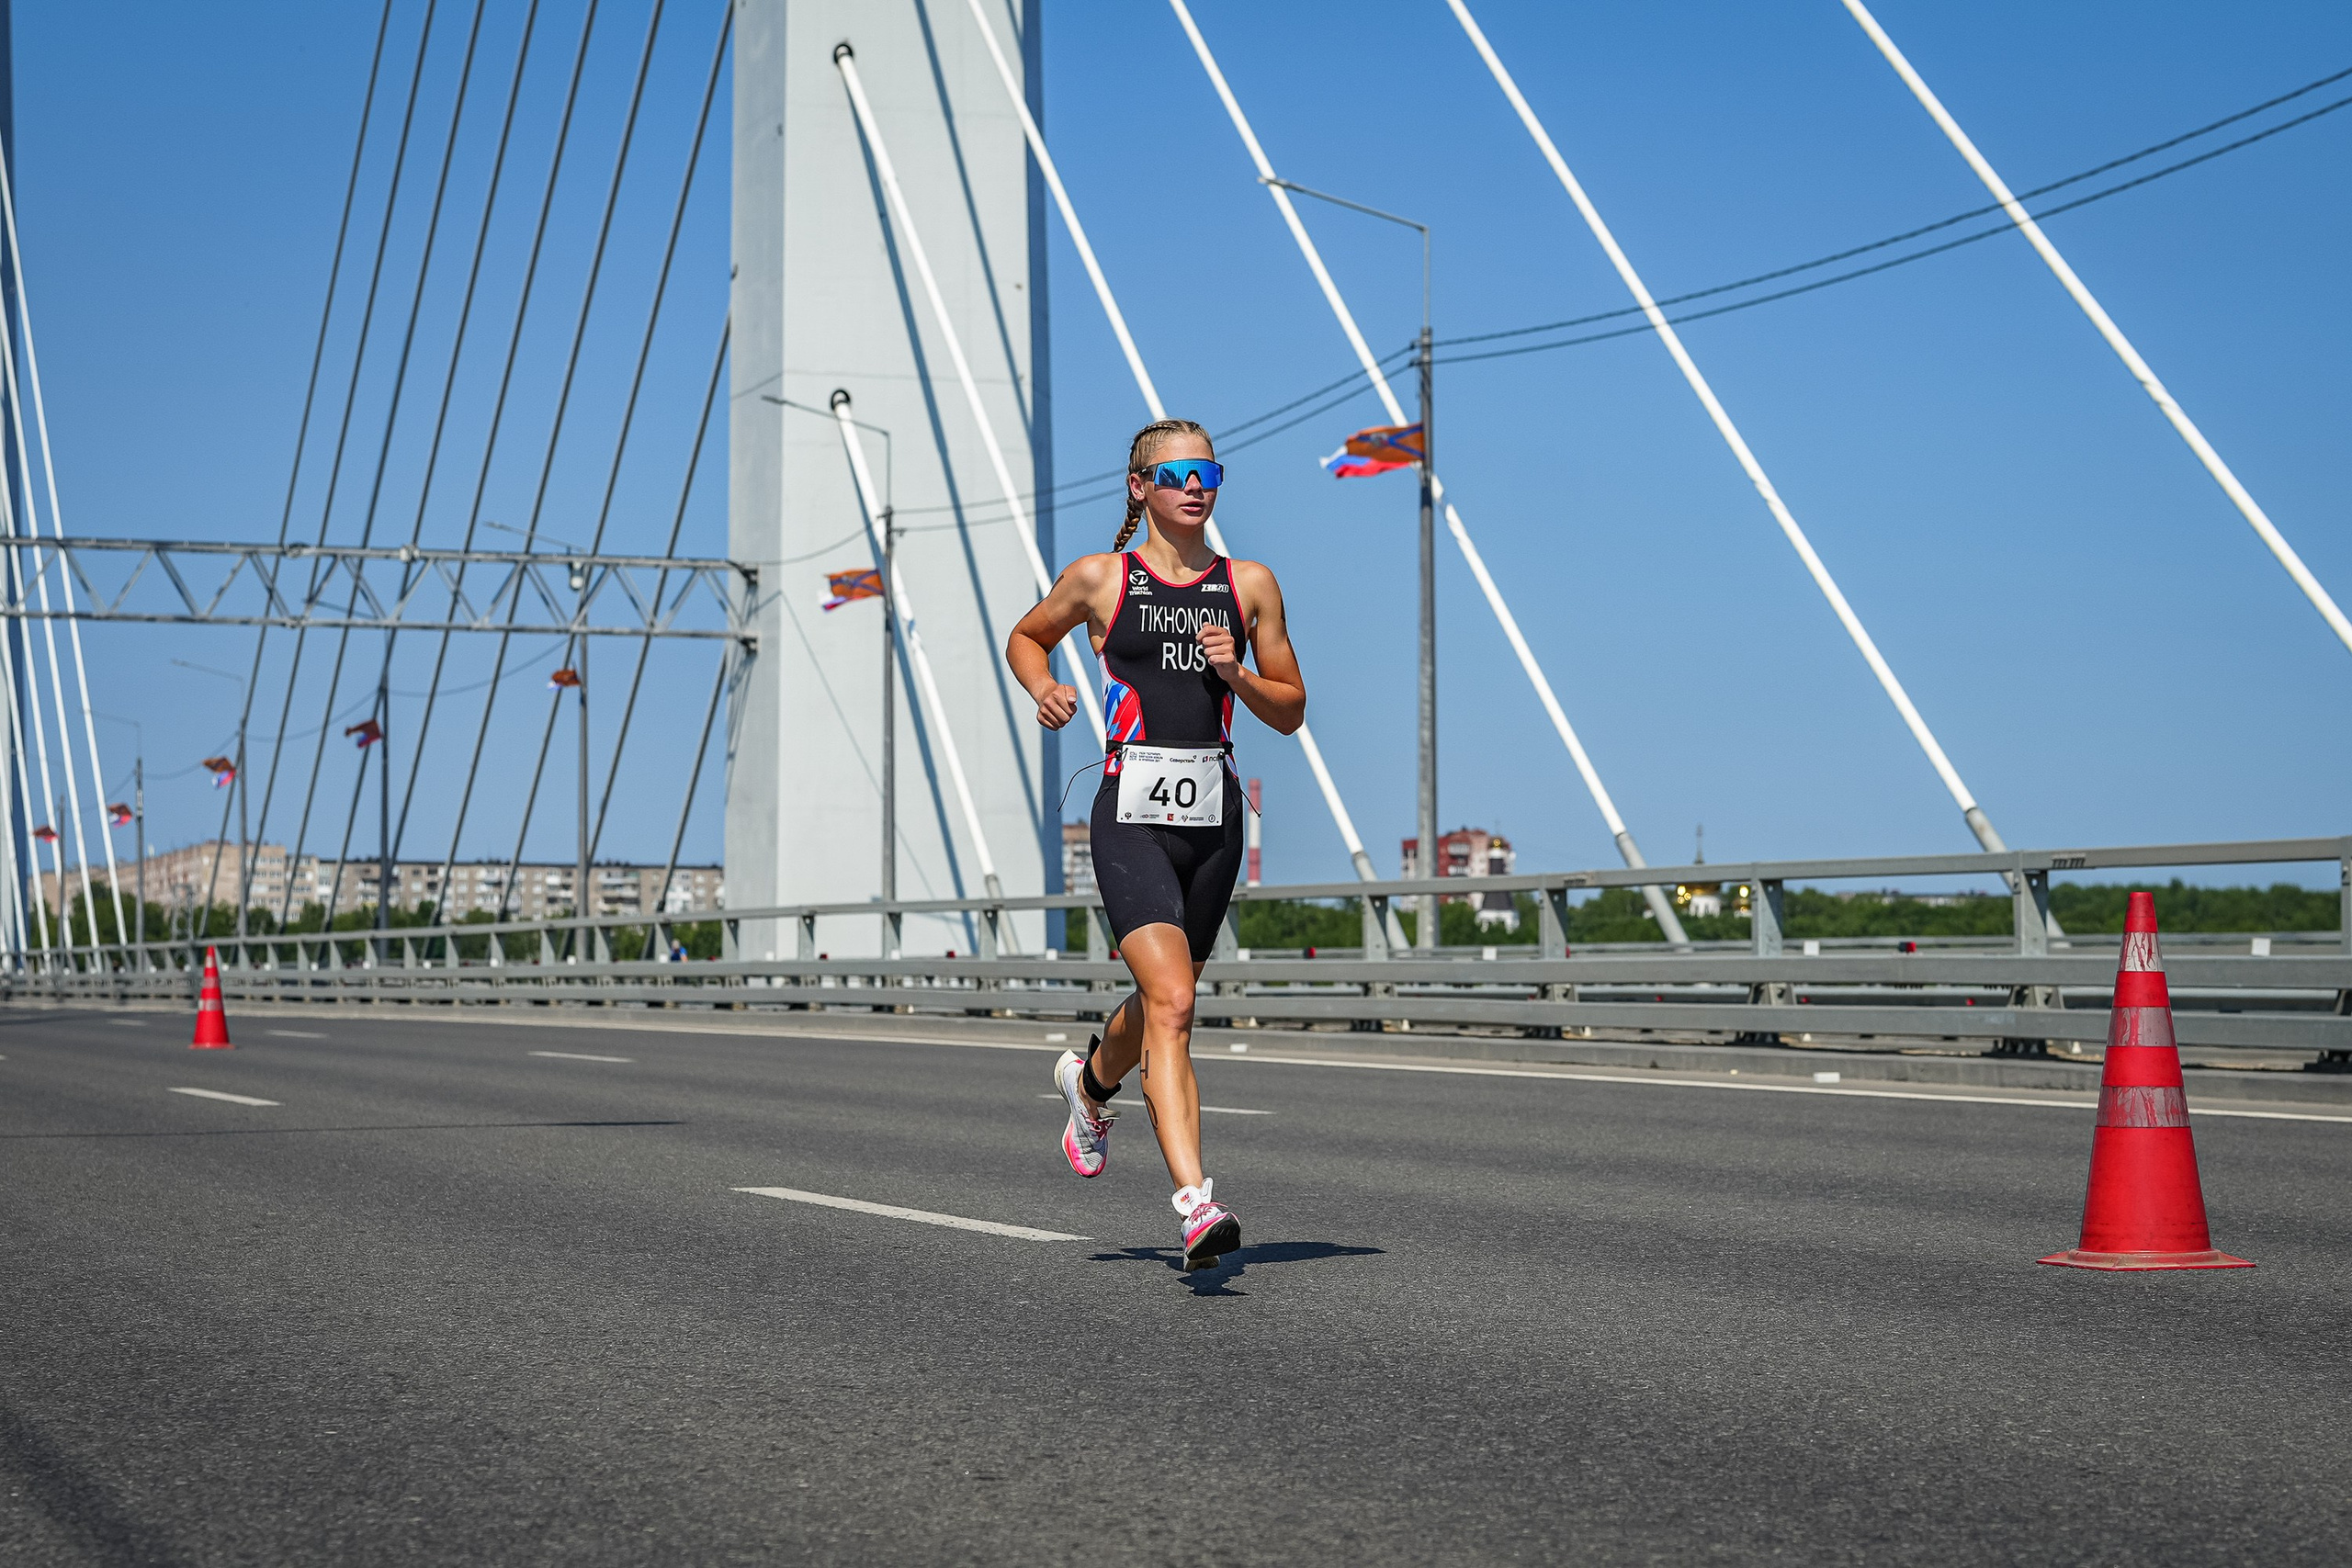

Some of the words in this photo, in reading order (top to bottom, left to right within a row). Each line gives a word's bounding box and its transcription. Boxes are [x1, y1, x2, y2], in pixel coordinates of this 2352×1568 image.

[1139, 604, 1231, 636] TIKHONOVA
[1162, 642, 1206, 672] RUS
[1148, 777, 1197, 808] 40
